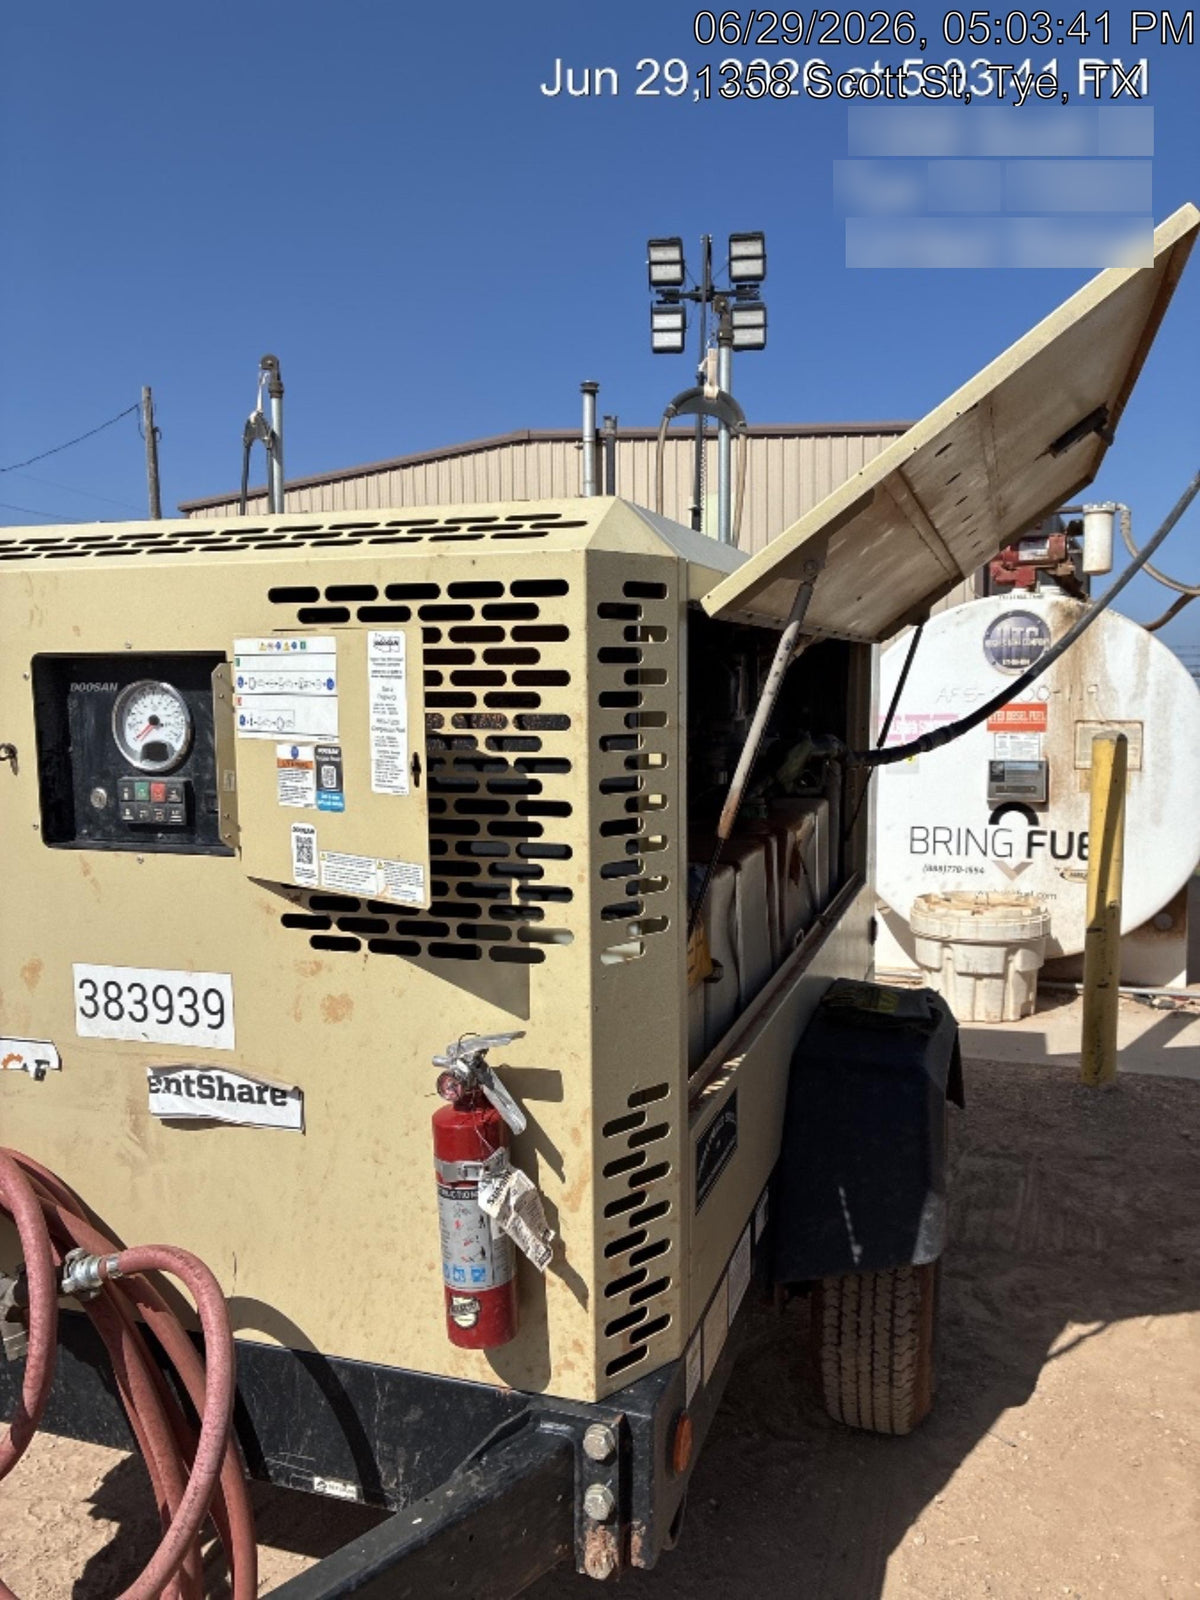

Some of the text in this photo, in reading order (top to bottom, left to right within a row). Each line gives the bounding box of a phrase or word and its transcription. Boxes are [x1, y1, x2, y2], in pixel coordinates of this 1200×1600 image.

[70, 682, 118, 692] DOOSAN
[910, 825, 1089, 861] BRING FUE
[79, 979, 225, 1030] 383939
